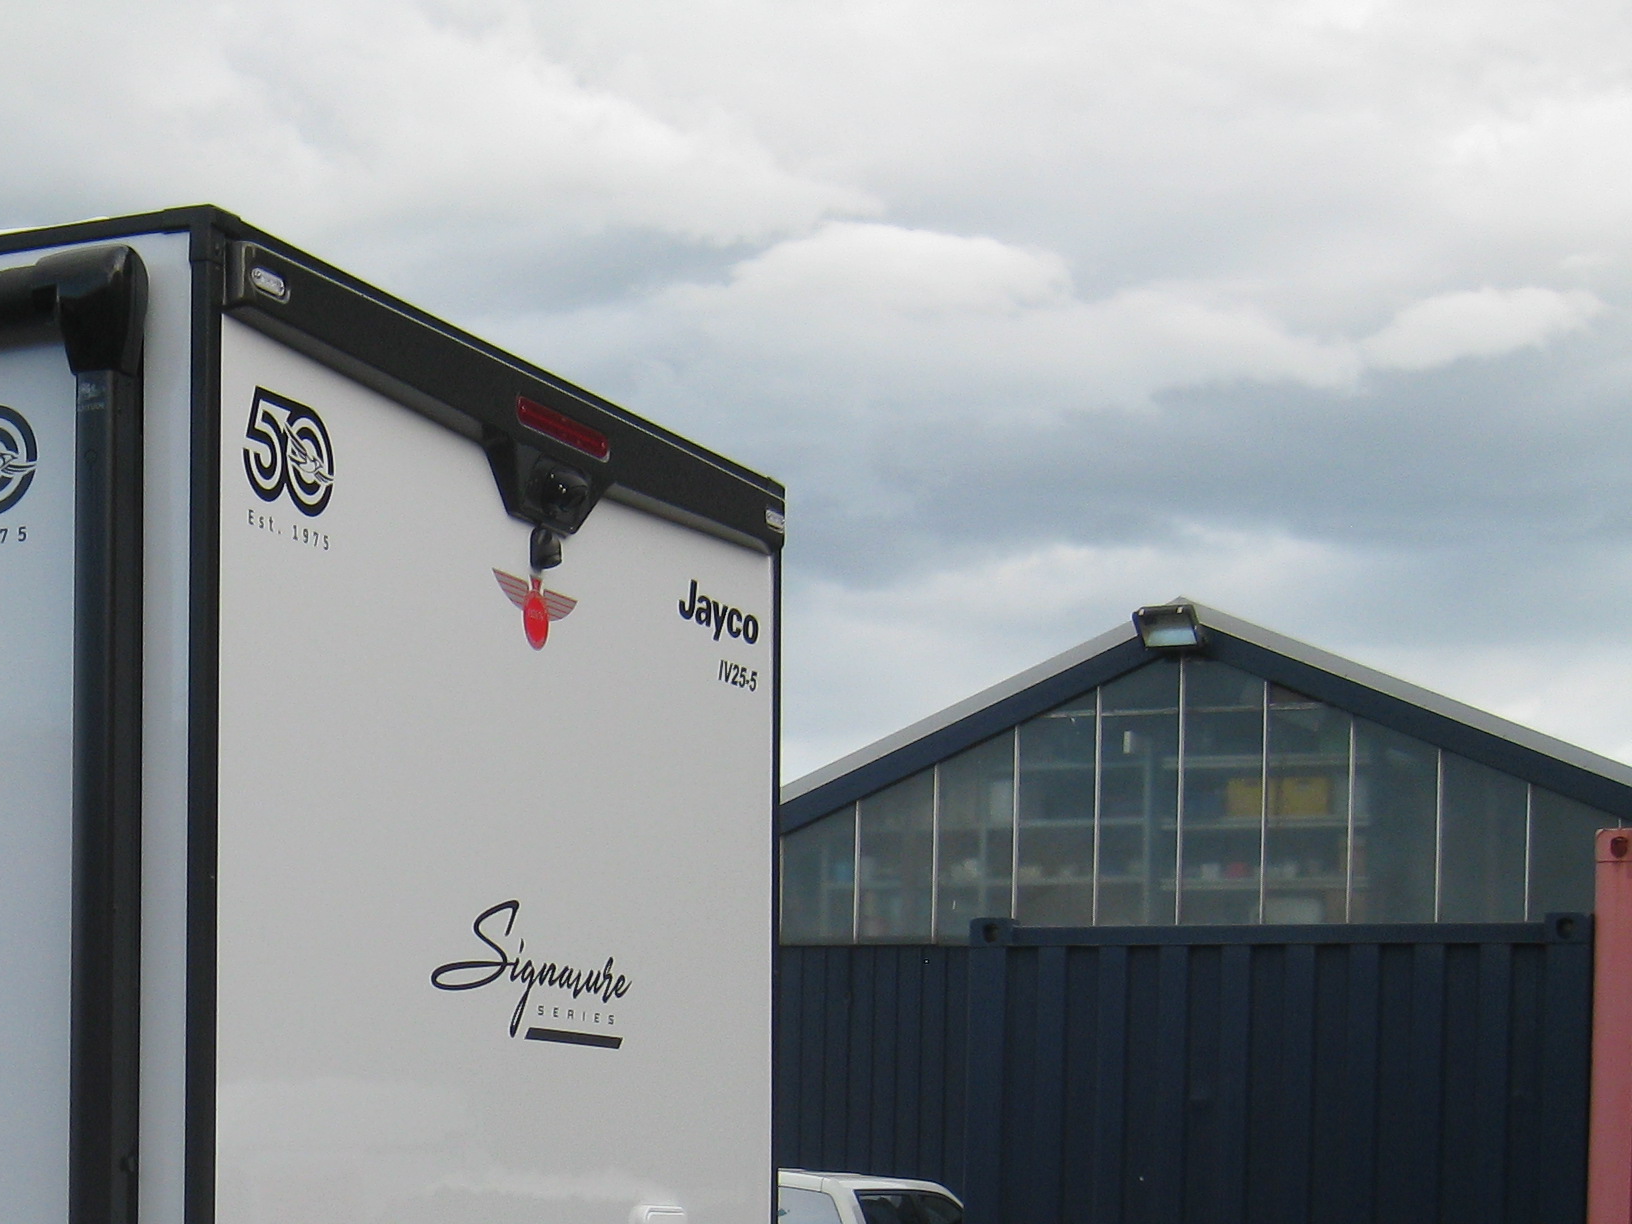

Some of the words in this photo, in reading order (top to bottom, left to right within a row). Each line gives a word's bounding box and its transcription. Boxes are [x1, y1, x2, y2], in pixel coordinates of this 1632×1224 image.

[247, 509, 282, 536] Est.
[291, 524, 331, 551] 1975
[678, 579, 760, 645] Jayco
[718, 660, 758, 692] IV25-5
[537, 1005, 616, 1025] SERIES
